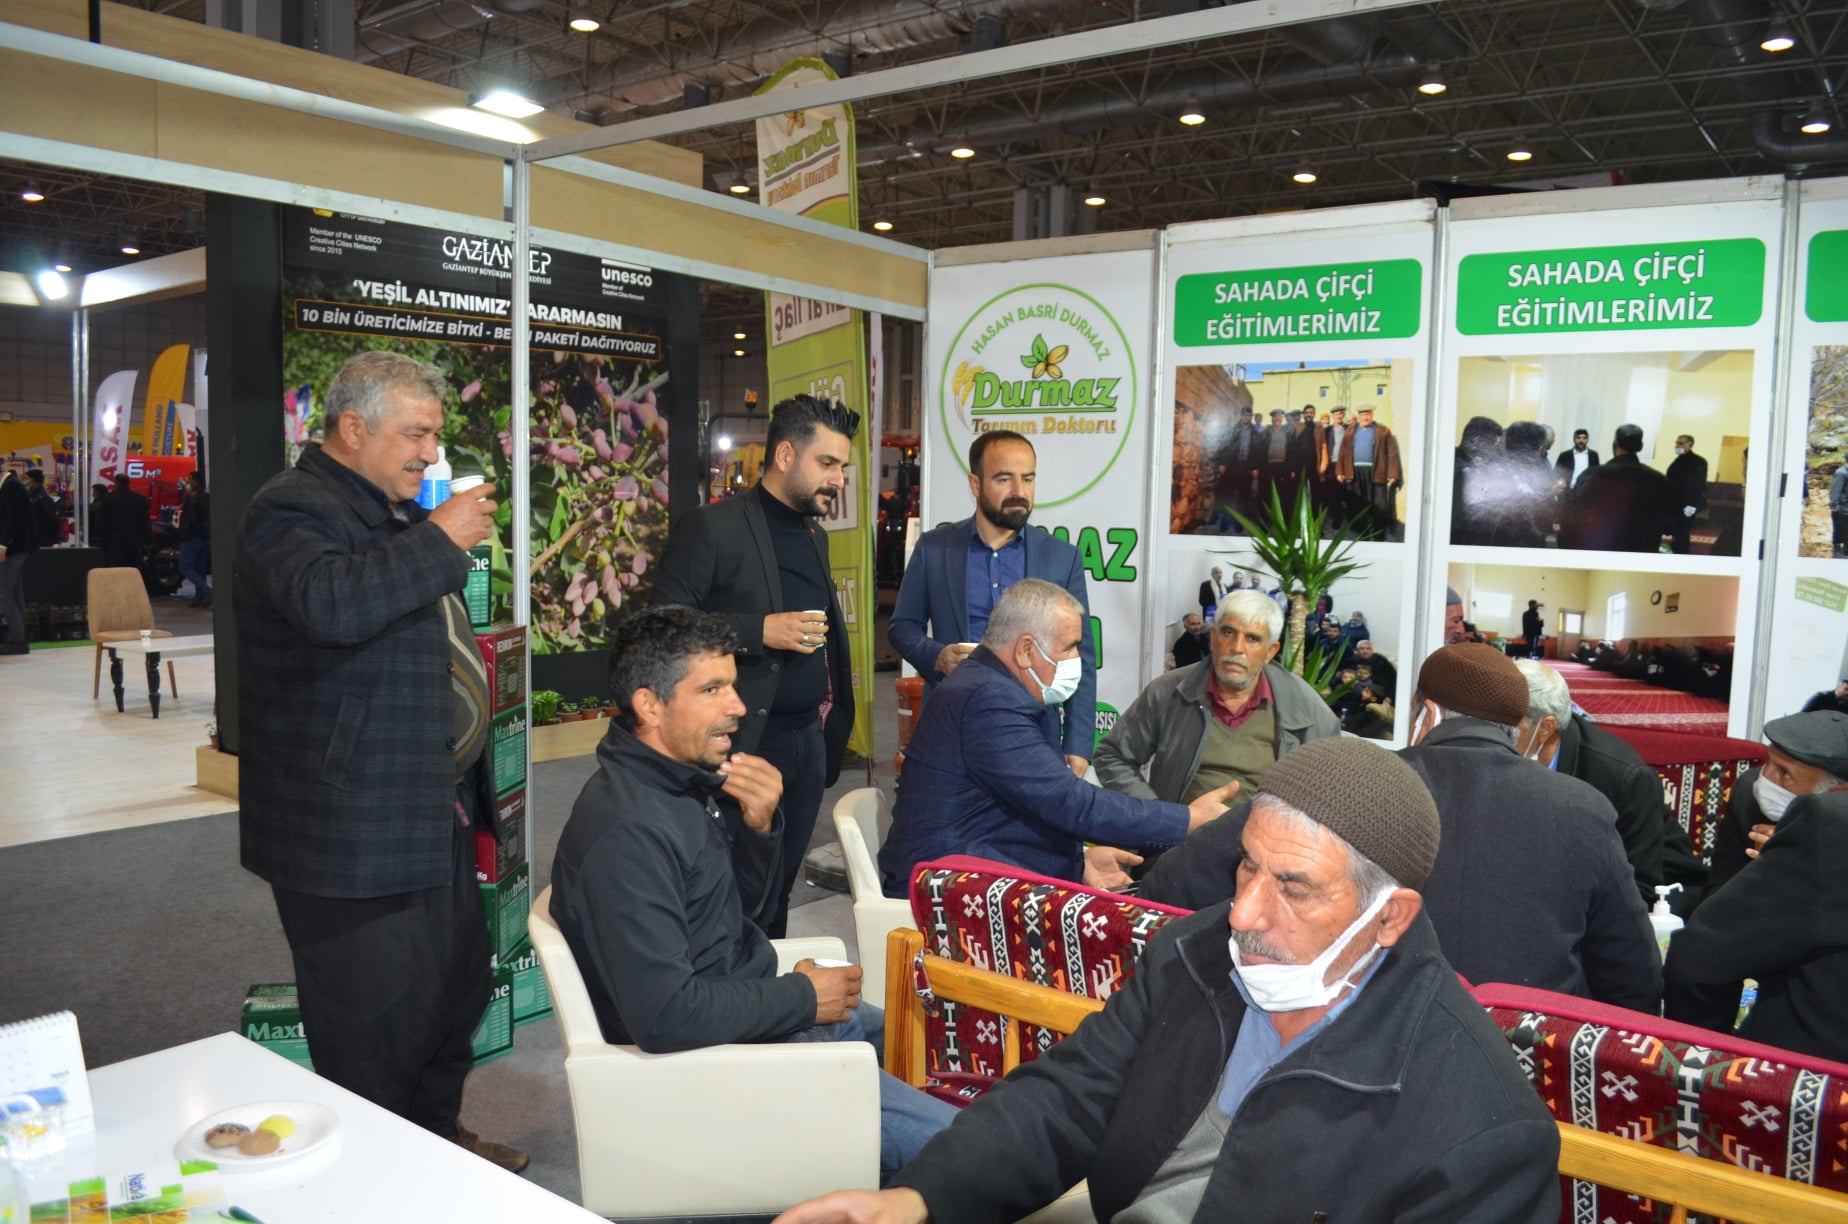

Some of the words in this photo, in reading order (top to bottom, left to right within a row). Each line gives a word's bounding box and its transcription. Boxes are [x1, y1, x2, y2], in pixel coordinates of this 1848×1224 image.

[309, 227, 335, 237] Member
[342, 232, 353, 240] the
[354, 234, 383, 244] UNESCO
[309, 236, 335, 246] Creative
[335, 239, 353, 249] Cities
[353, 242, 378, 252] Network
[309, 245, 326, 253] since
[327, 246, 343, 255] 2015
[442, 236, 552, 275] GAZİANEP
[1507, 259, 1625, 288] SAHADA
[1633, 248, 1706, 287] ÇİFÇİ
[442, 262, 479, 275] GAZİANTEP
[479, 267, 513, 280] BÜYÜKŞEH
[601, 267, 653, 288] unesco
[1214, 278, 1309, 304] SAHADA
[1315, 268, 1374, 302] ÇİFÇİ
[528, 303, 622, 330] ARARMASIN
[1206, 306, 1382, 340] EĞİTİMLERİMİZ
[1496, 290, 1714, 328] EĞİTİMLERİMİZ
[302, 308, 319, 322] 10
[322, 307, 351, 325] BİN
[354, 310, 445, 334] ÜRETİCİMİZE
[447, 320, 485, 337] BİTKİ
[534, 331, 580, 347] PAKETİ
[581, 334, 657, 354] DAĞITIYORUZ
[970, 311, 1015, 356] HASAN
[1016, 302, 1059, 322] BASRİ
[1060, 307, 1112, 362] DURMAZ
[971, 371, 1122, 409] Durmaz
[164, 421, 174, 456] CULTURE
[971, 417, 1038, 435] Tarımın
[1041, 415, 1117, 434] Doktoru
[127, 462, 144, 479] 6
[494, 714, 526, 743] Maxtrine
[247, 1021, 307, 1041] Maxt
